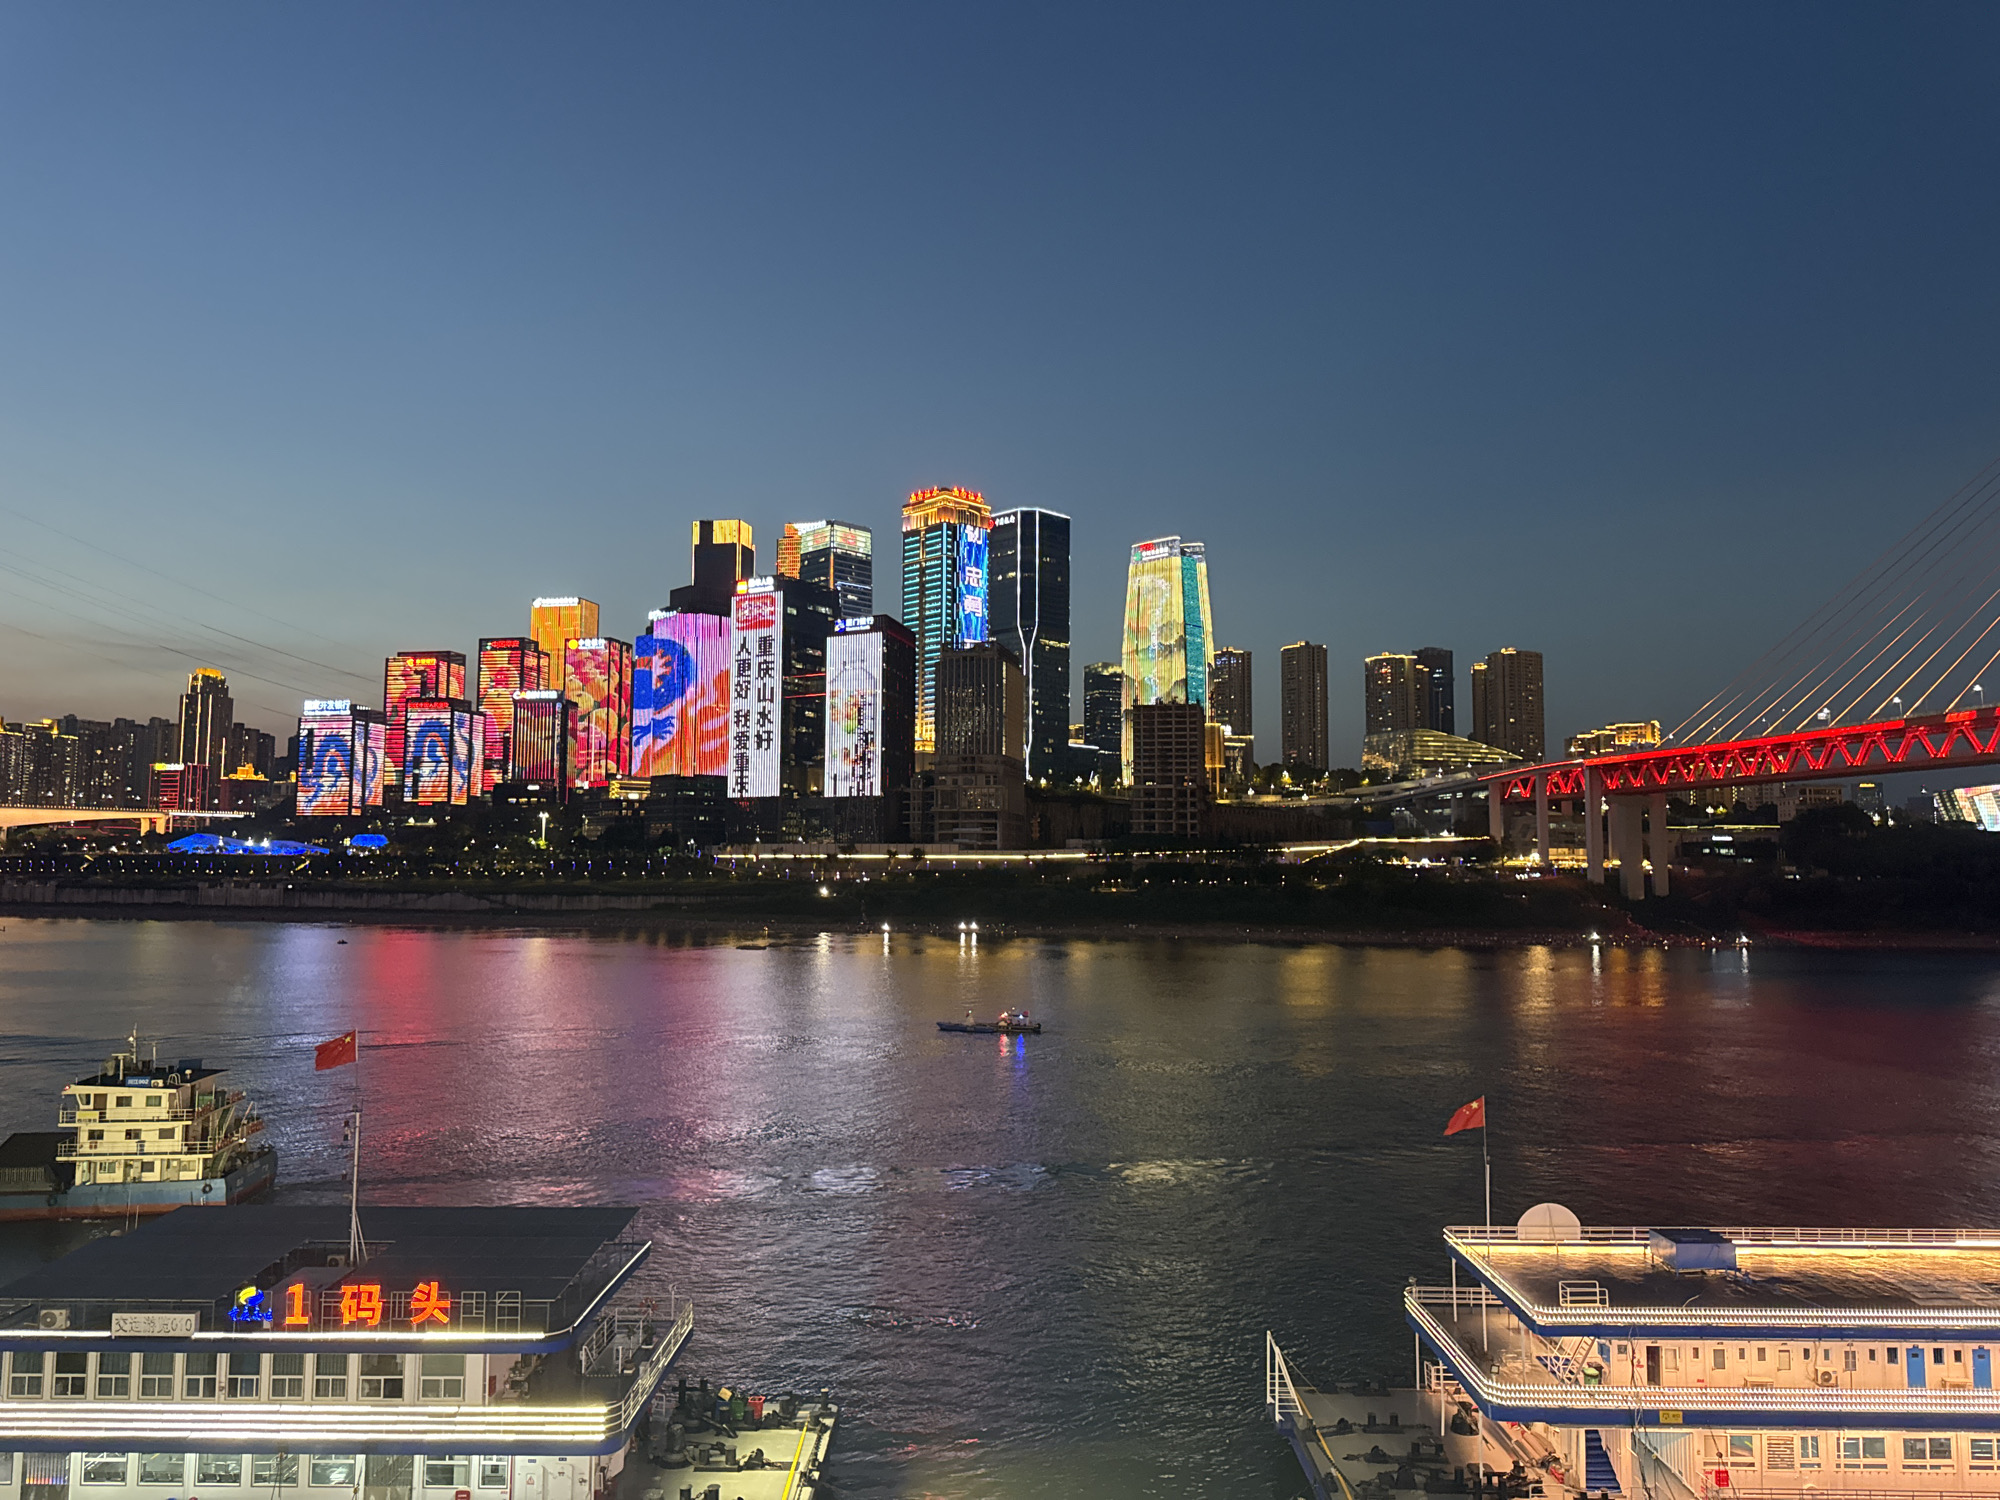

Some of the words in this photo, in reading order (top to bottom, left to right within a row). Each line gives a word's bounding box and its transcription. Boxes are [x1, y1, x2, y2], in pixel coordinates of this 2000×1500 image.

[755, 634, 775, 751] 重庆山水好
